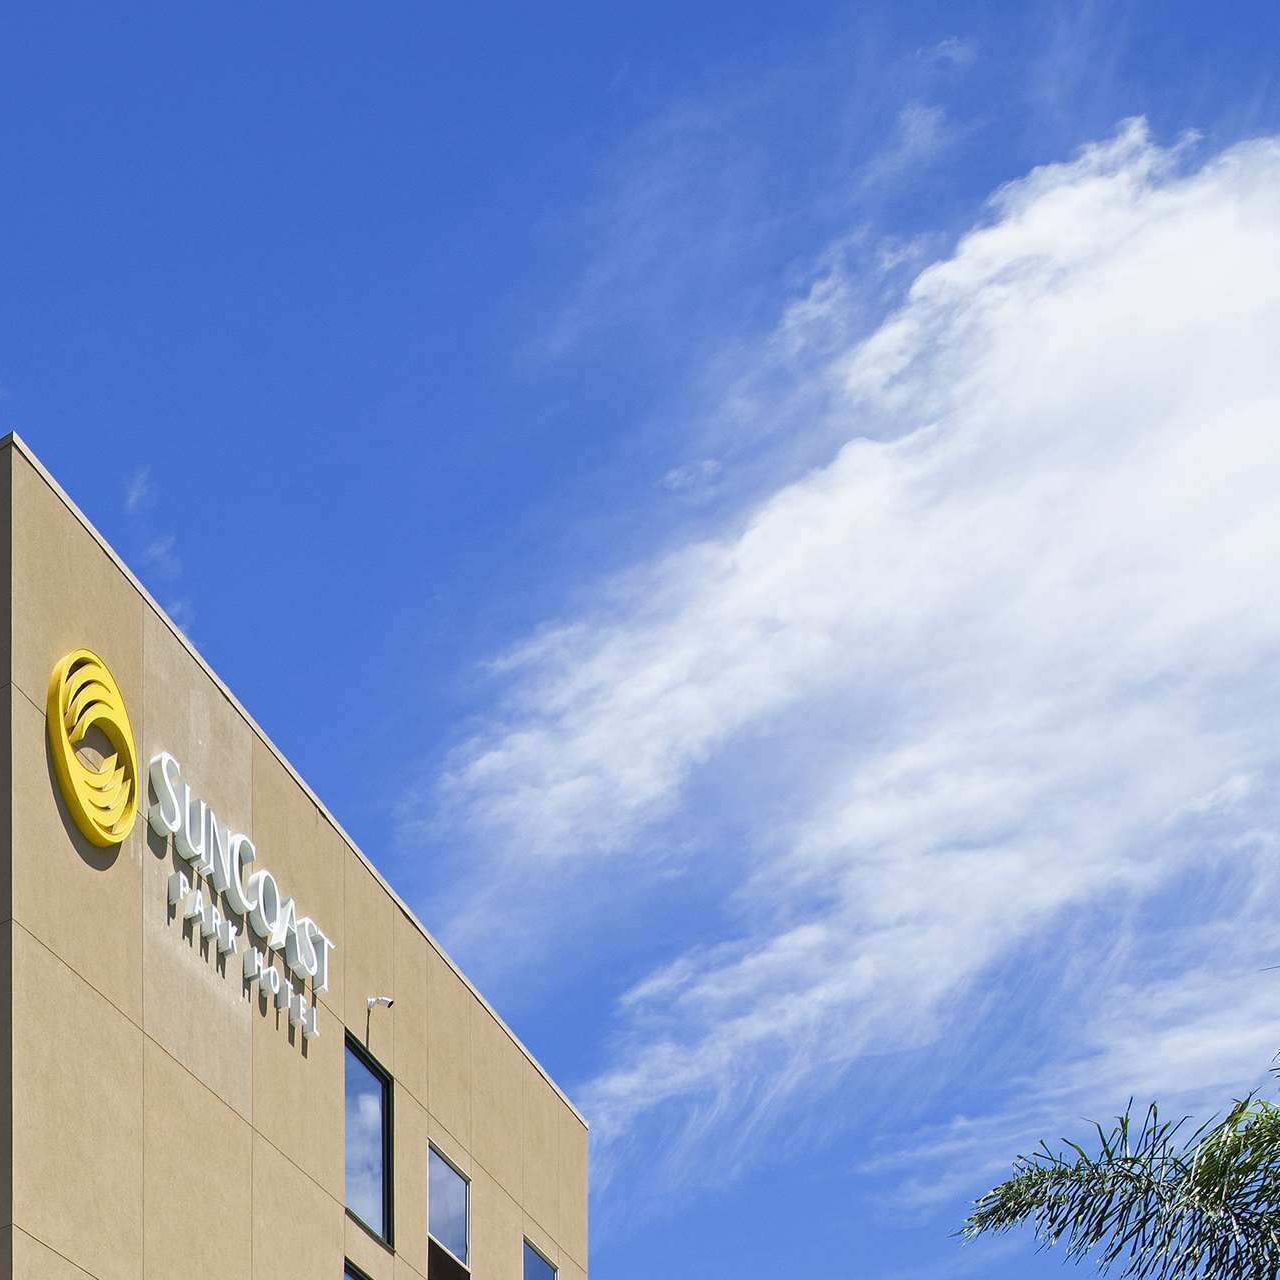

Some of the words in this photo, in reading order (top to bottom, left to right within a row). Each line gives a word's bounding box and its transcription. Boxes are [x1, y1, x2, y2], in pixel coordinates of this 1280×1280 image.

[149, 752, 335, 995] SUNCOAST
[169, 870, 237, 959] PARK
[243, 946, 320, 1041] HOTEL
